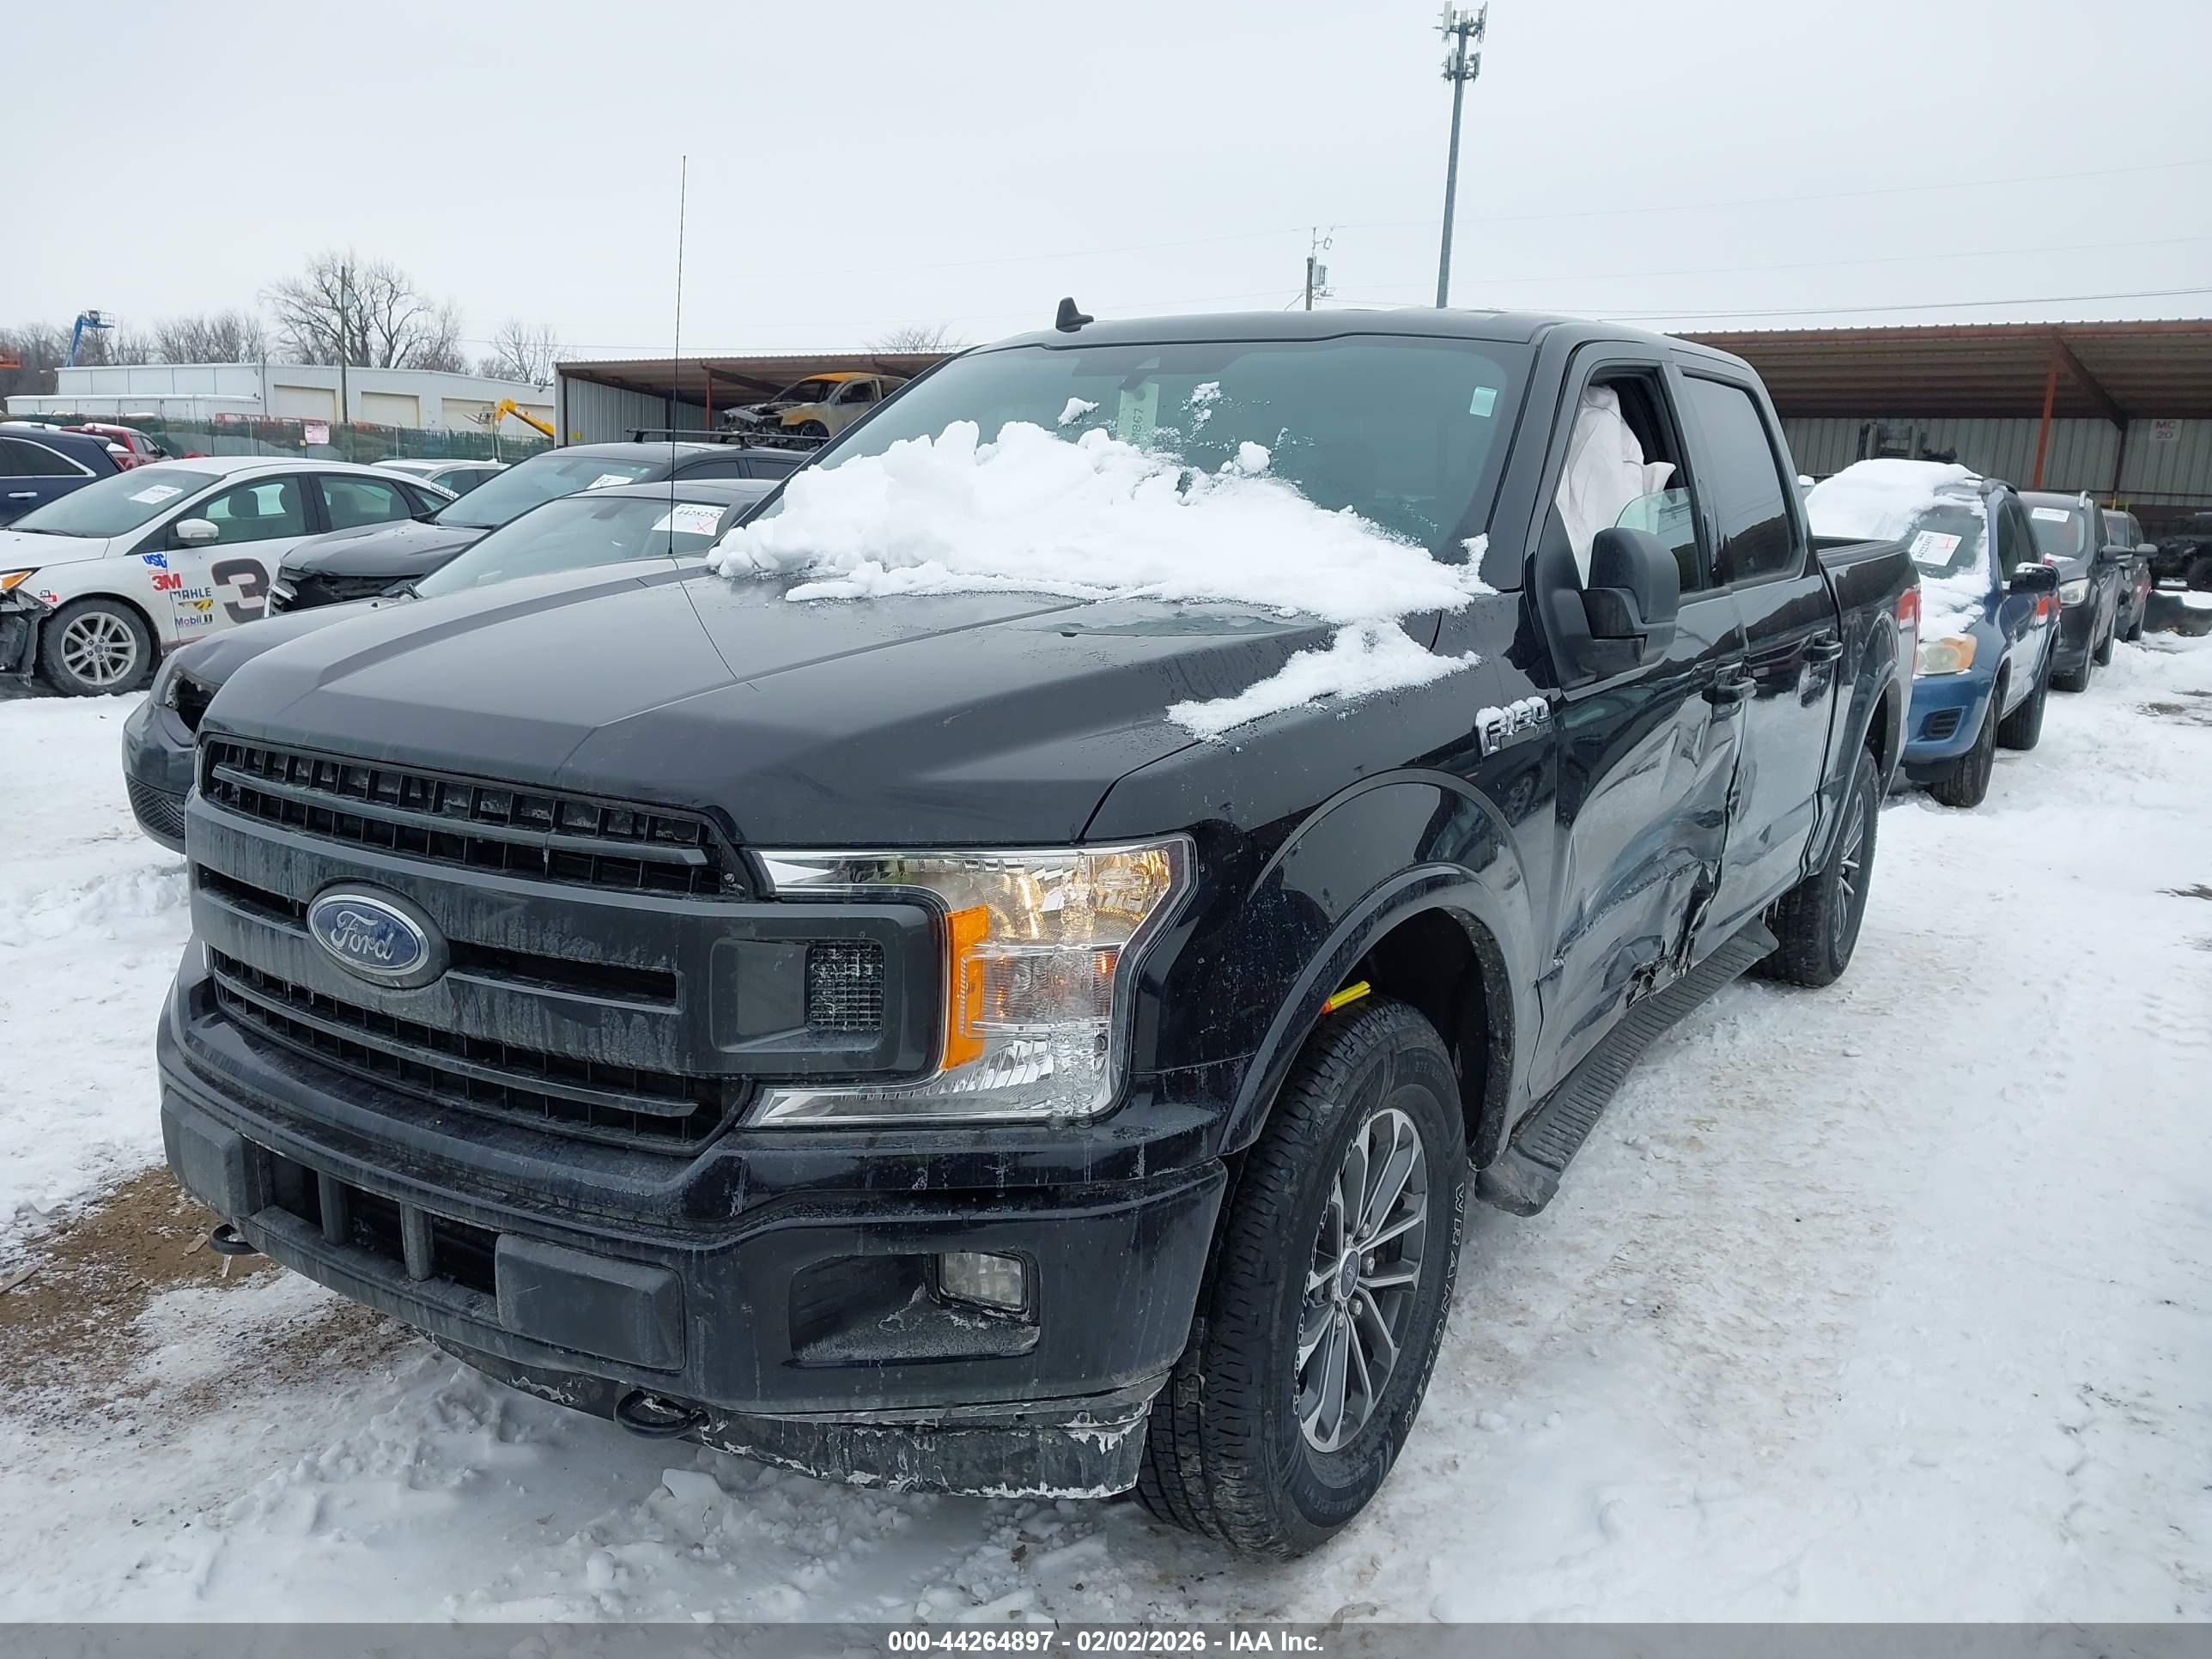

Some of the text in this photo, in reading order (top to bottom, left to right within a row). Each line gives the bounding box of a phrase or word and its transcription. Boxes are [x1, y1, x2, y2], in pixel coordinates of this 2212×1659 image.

[2156, 421, 2177, 430] MC
[2156, 430, 2173, 440] 20
[152, 573, 182, 591] 3M
[169, 587, 212, 600] MAHLE
[211, 558, 270, 623] 3
[174, 614, 202, 626] Mobil
[330, 910, 395, 960] Ford
[1404, 1182, 1465, 1432] WRANGLER
